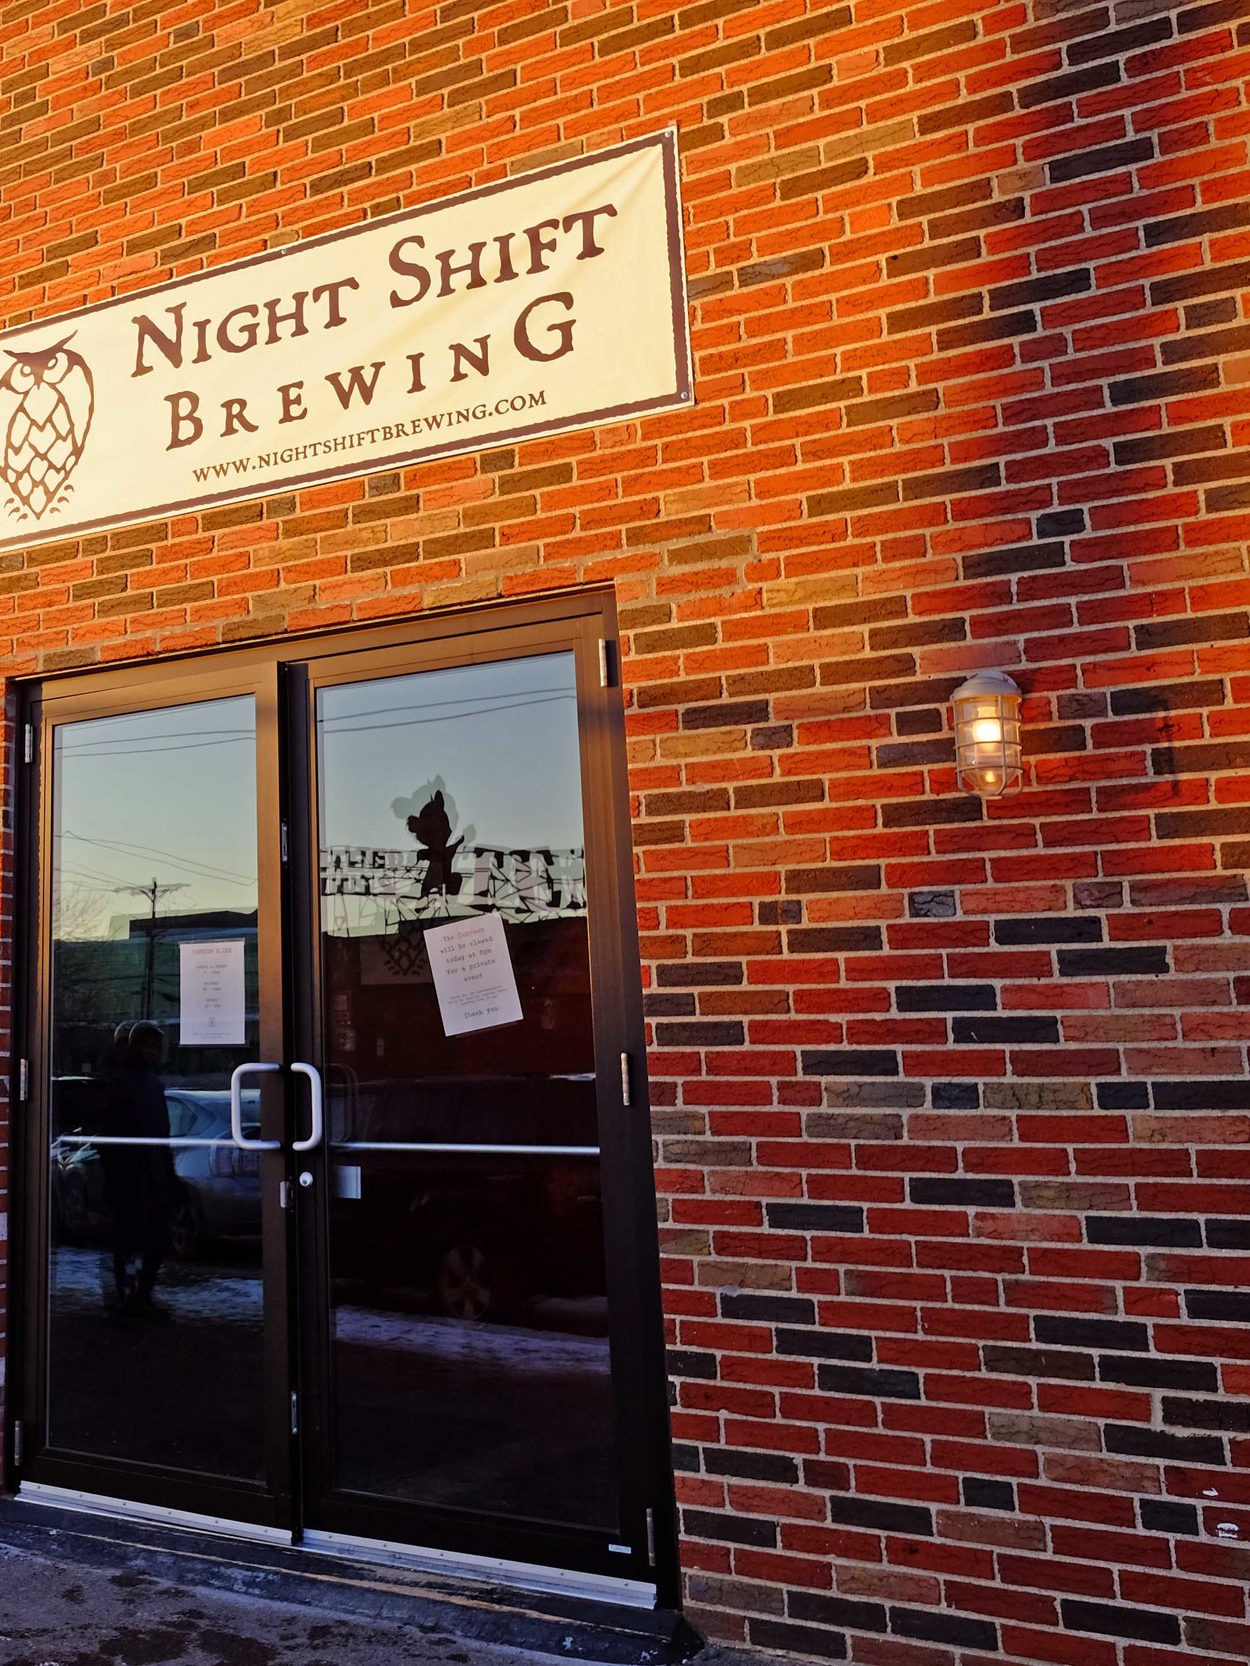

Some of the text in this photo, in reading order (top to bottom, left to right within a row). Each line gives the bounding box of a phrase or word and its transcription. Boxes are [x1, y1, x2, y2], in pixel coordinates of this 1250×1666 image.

[131, 204, 617, 378] NIGHT SHIFT
[164, 291, 577, 452] BREWING
[192, 390, 548, 483] WWW.NIGHTSHIFTBREWING.COM
[440, 945, 455, 954] will
[470, 936, 493, 947] closed
[446, 954, 465, 964] today
[469, 959, 495, 970] private
[464, 973, 483, 982] event
